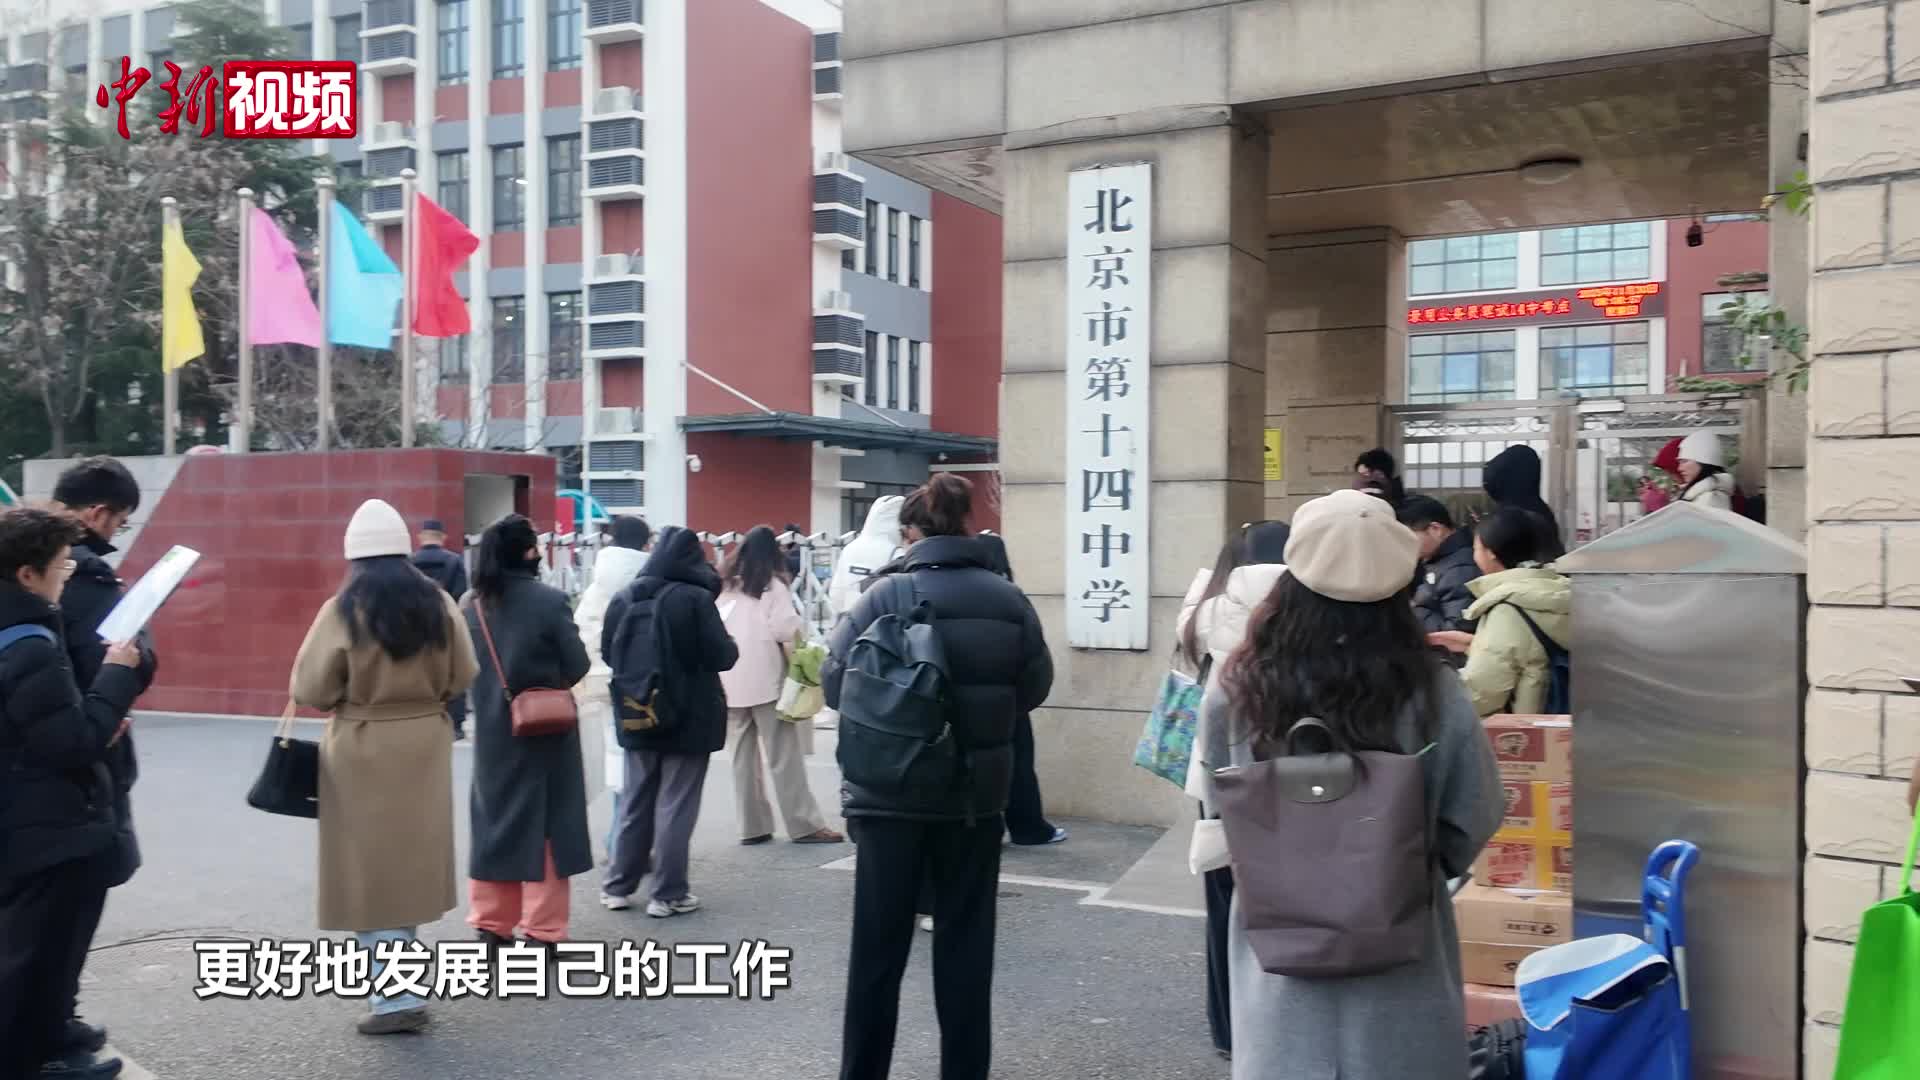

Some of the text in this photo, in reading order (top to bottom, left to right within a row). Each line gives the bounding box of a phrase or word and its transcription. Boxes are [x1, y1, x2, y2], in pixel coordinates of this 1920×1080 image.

[1081, 188, 1136, 624] 北京市第十四中学
